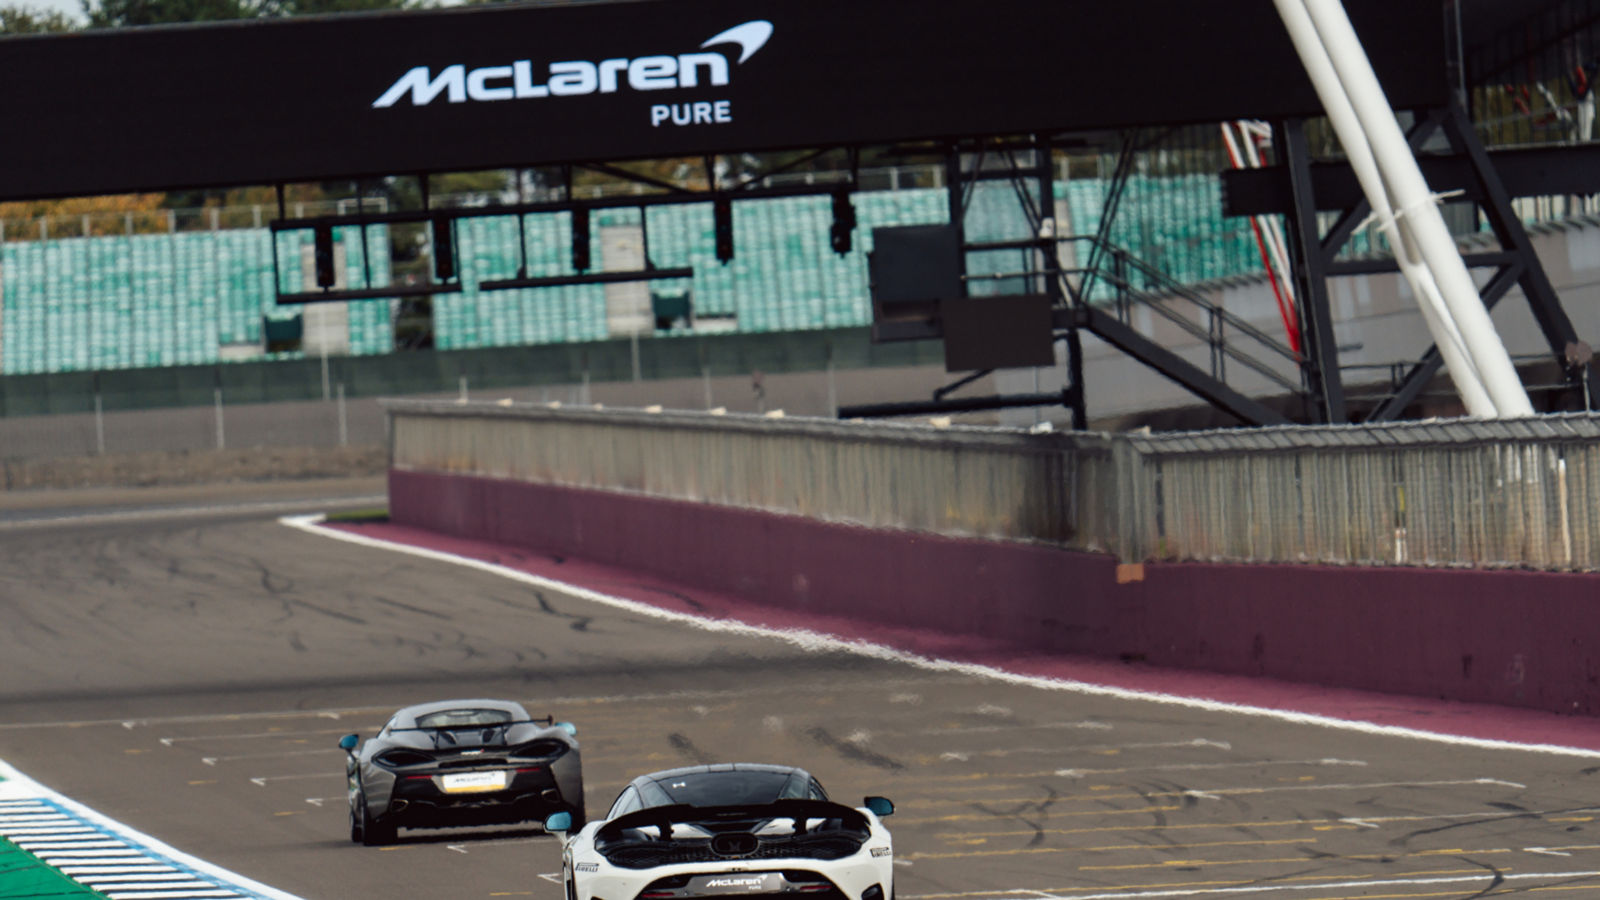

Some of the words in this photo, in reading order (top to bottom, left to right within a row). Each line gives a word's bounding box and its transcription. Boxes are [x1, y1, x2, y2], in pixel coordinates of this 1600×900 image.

[372, 52, 730, 108] McLaren
[650, 100, 733, 127] PURE
[706, 878, 761, 888] McLaren
